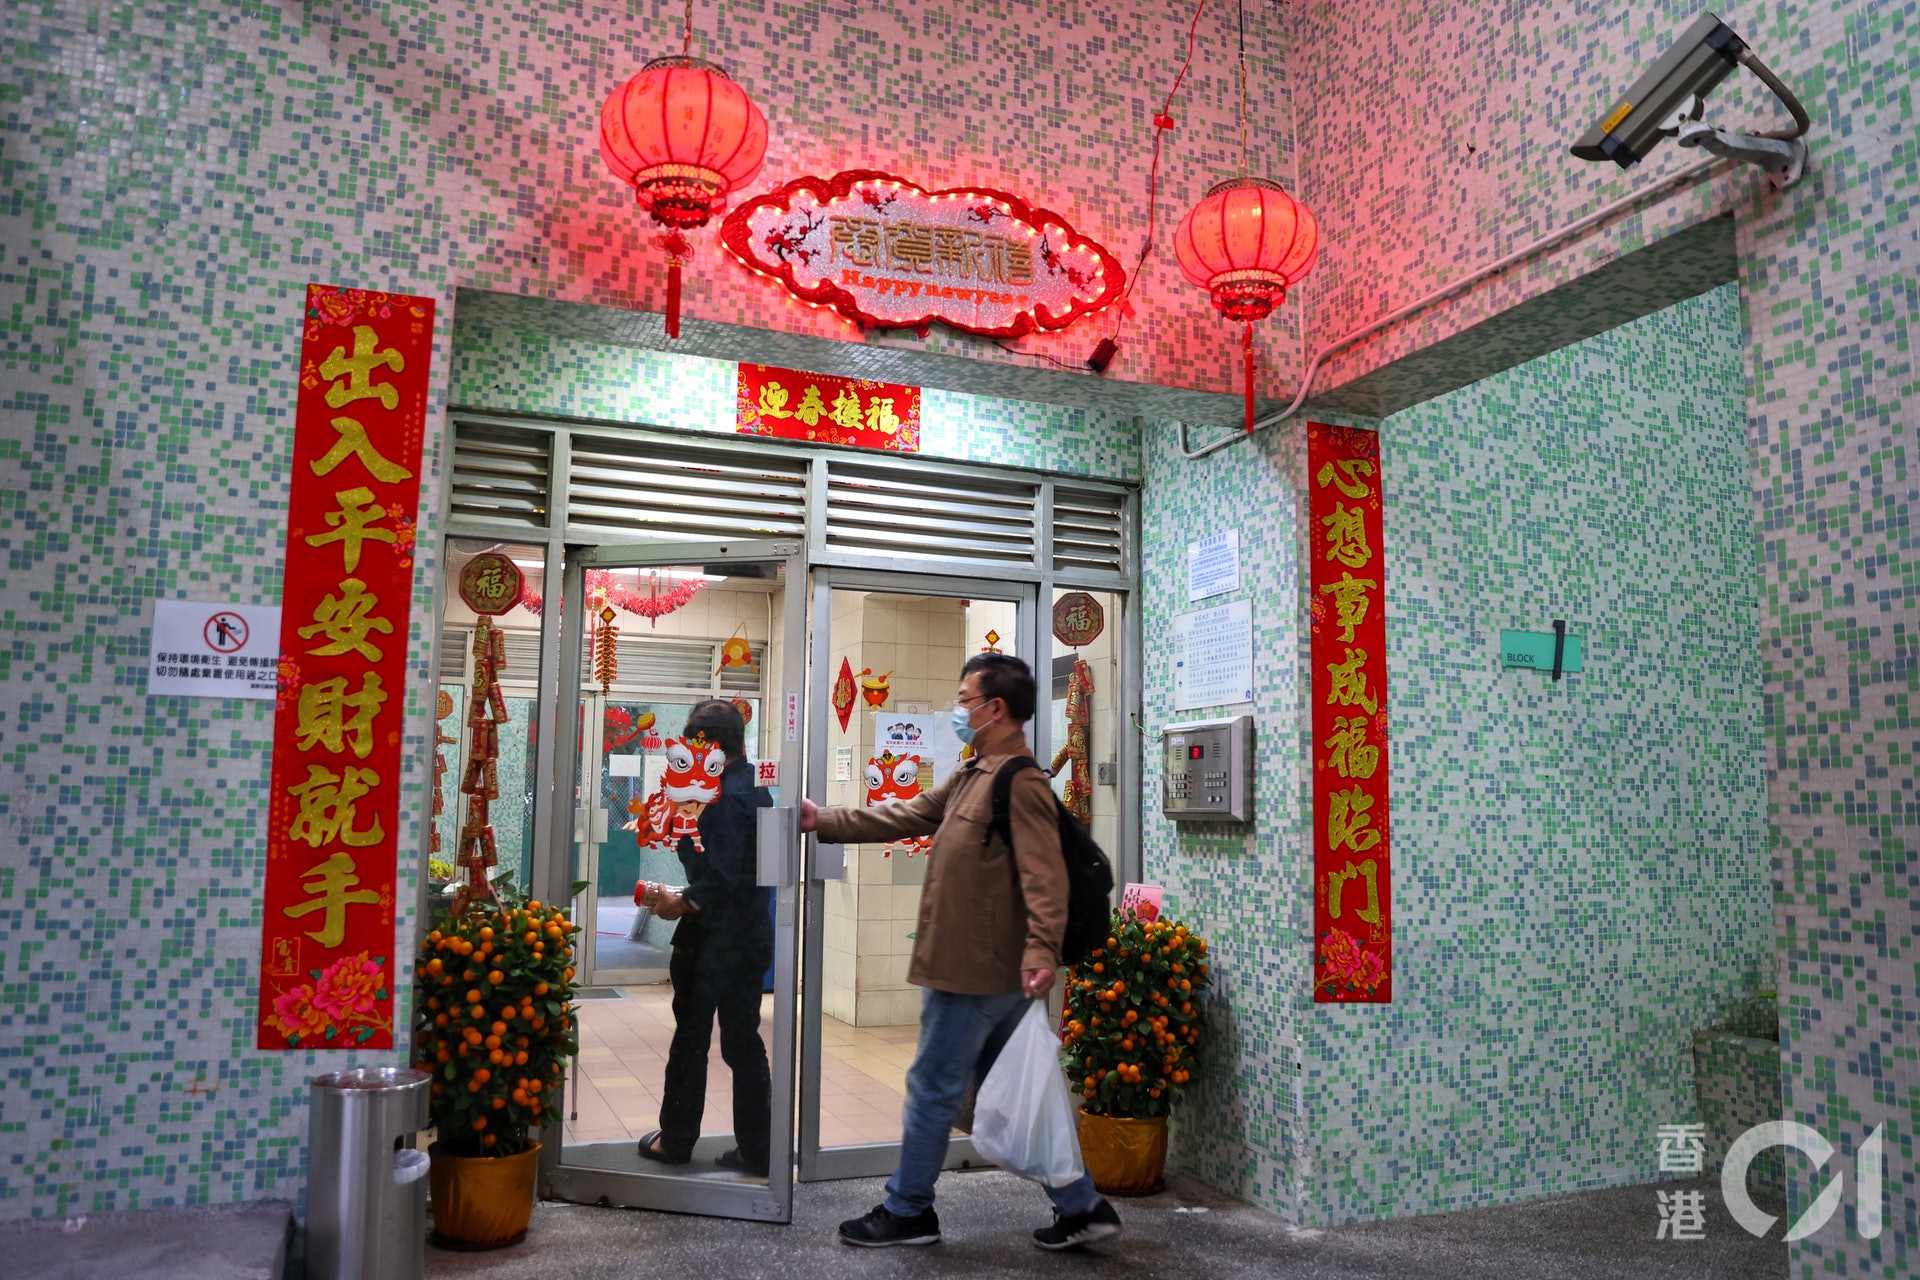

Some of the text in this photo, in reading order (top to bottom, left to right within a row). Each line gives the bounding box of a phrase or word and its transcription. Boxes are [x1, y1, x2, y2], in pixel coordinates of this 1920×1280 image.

[758, 380, 900, 435] 迎春接福
[476, 568, 507, 598] 福
[283, 325, 414, 949] 出入平安財就手
[1066, 605, 1092, 633] 福
[1507, 619, 1566, 683] BLOCK 1
[1317, 458, 1382, 924] 心想事成福臨門
[758, 762, 776, 780] 拉
